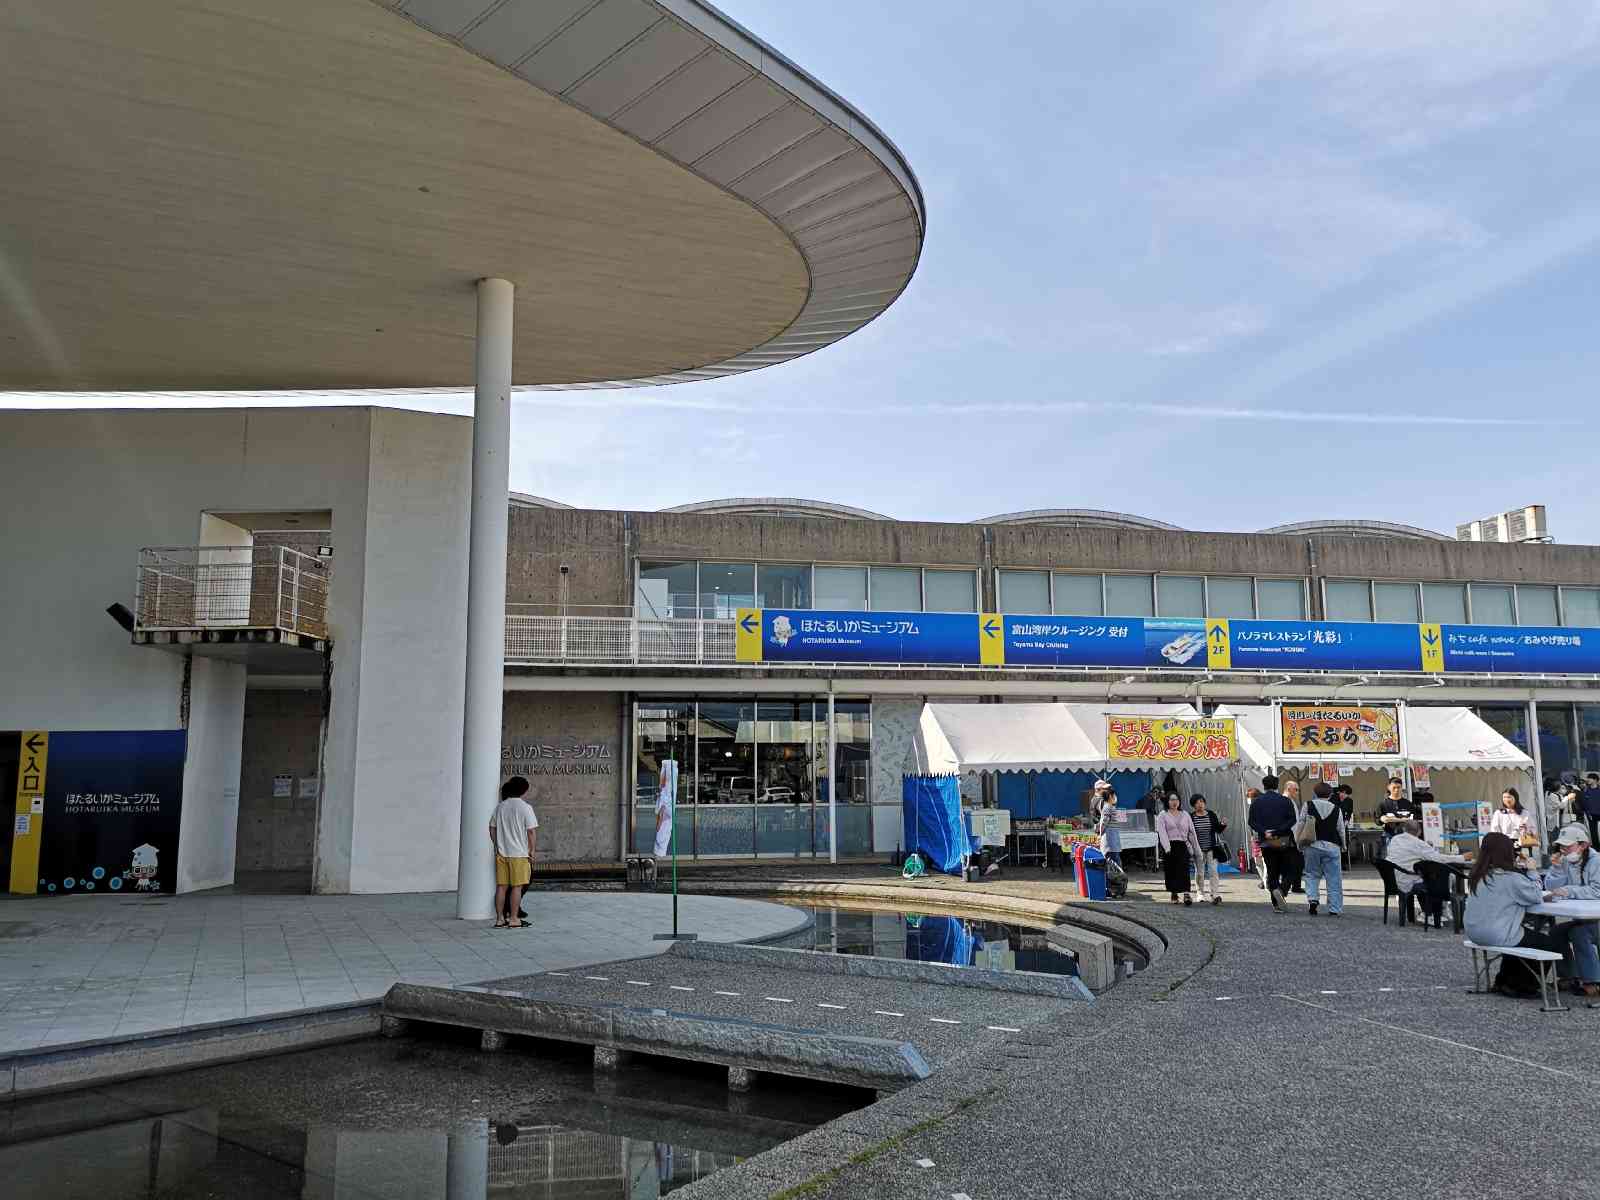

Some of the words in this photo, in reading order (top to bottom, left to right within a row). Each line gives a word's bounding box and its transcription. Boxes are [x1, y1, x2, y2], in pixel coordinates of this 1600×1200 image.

[801, 619, 920, 634] ほたるいかミュージアム
[1108, 625, 1128, 638] 受付
[1212, 645, 1225, 655] 2F
[1426, 649, 1438, 658] 1F
[1300, 724, 1358, 746] 天ぷら
[502, 743, 612, 759] るいかミュージアム
[23, 756, 41, 791] 入口
[65, 792, 160, 804] ほたるいかミュージアム
